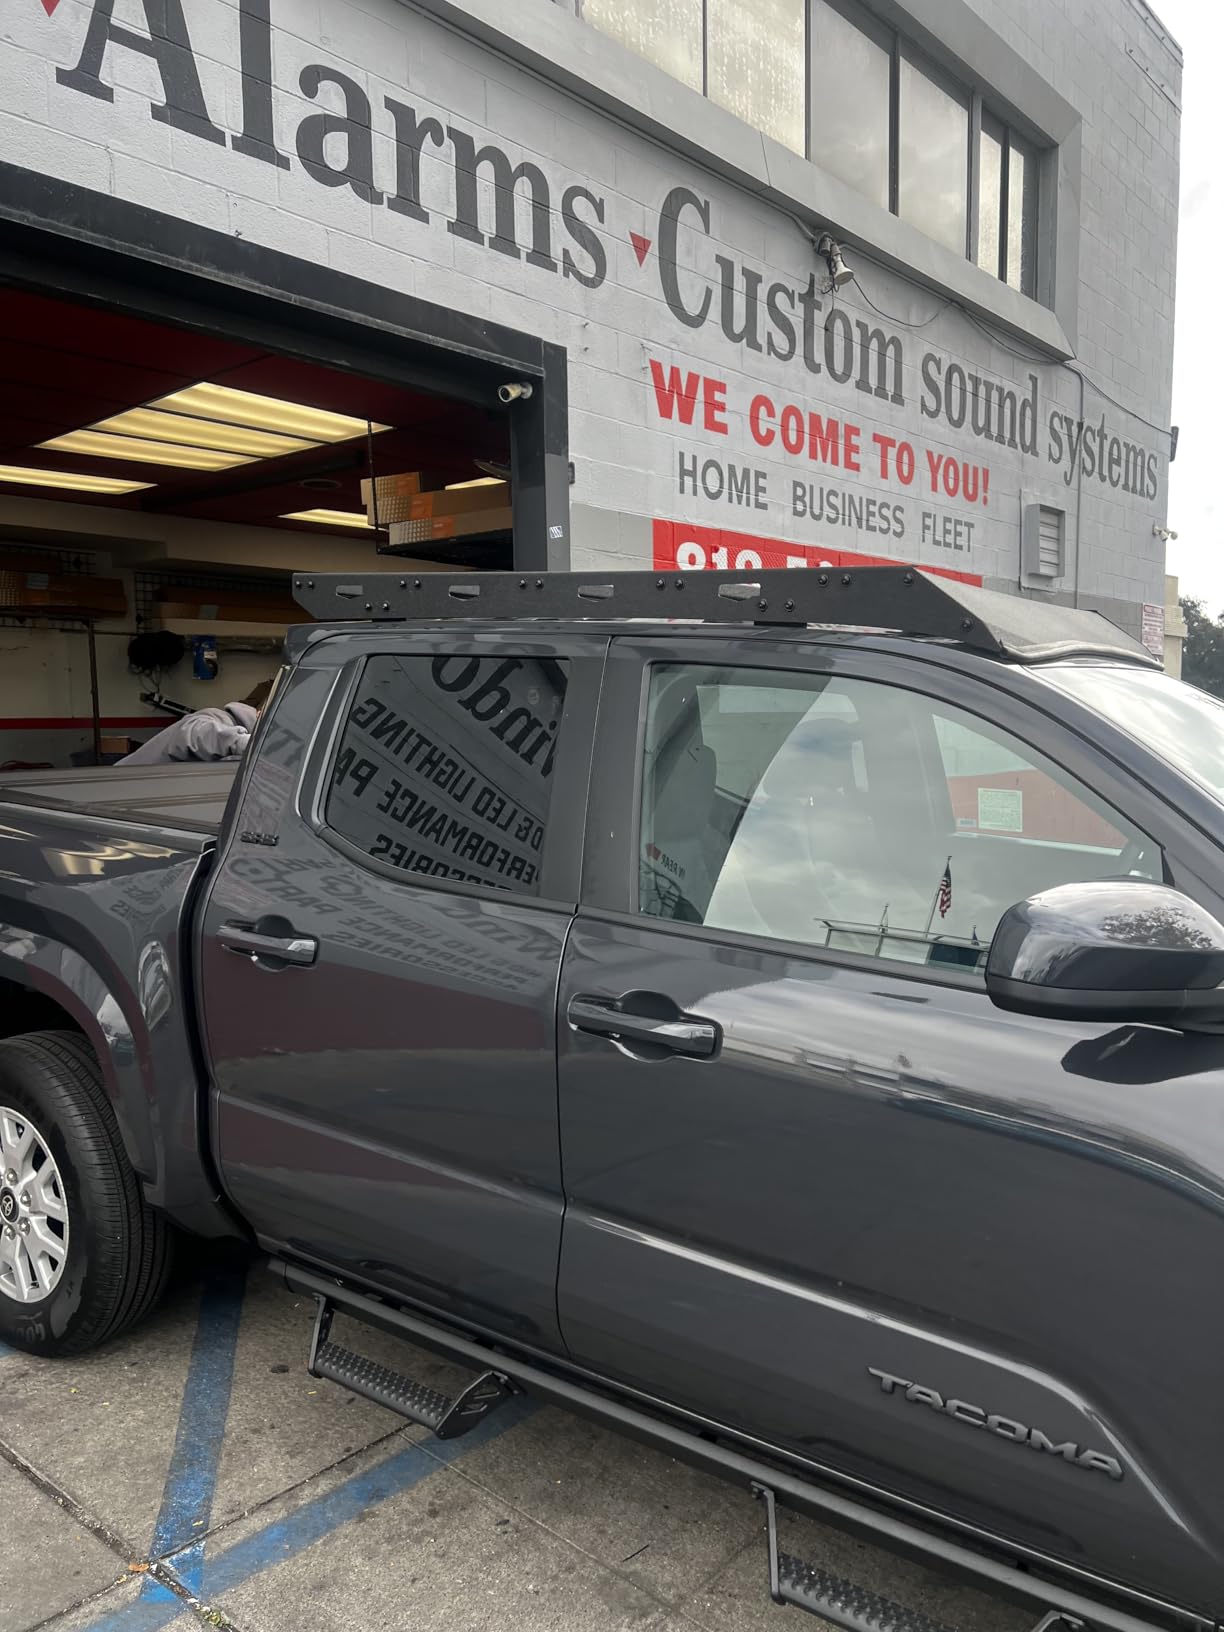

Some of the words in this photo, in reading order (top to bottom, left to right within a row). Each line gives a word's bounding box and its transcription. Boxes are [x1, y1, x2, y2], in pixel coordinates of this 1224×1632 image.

[55, 0, 607, 289] Alarms
[658, 187, 905, 407] Custom
[920, 352, 1039, 458] sound
[1048, 412, 1157, 501] systems
[649, 358, 728, 435] WE
[749, 394, 861, 472] COME
[872, 432, 915, 485] TO
[925, 449, 990, 506] YOU!
[678, 450, 769, 511] HOME
[792, 480, 905, 539] BUSINESS
[921, 511, 975, 553] FLEET
[866, 1366, 1125, 1481] TACOMA
